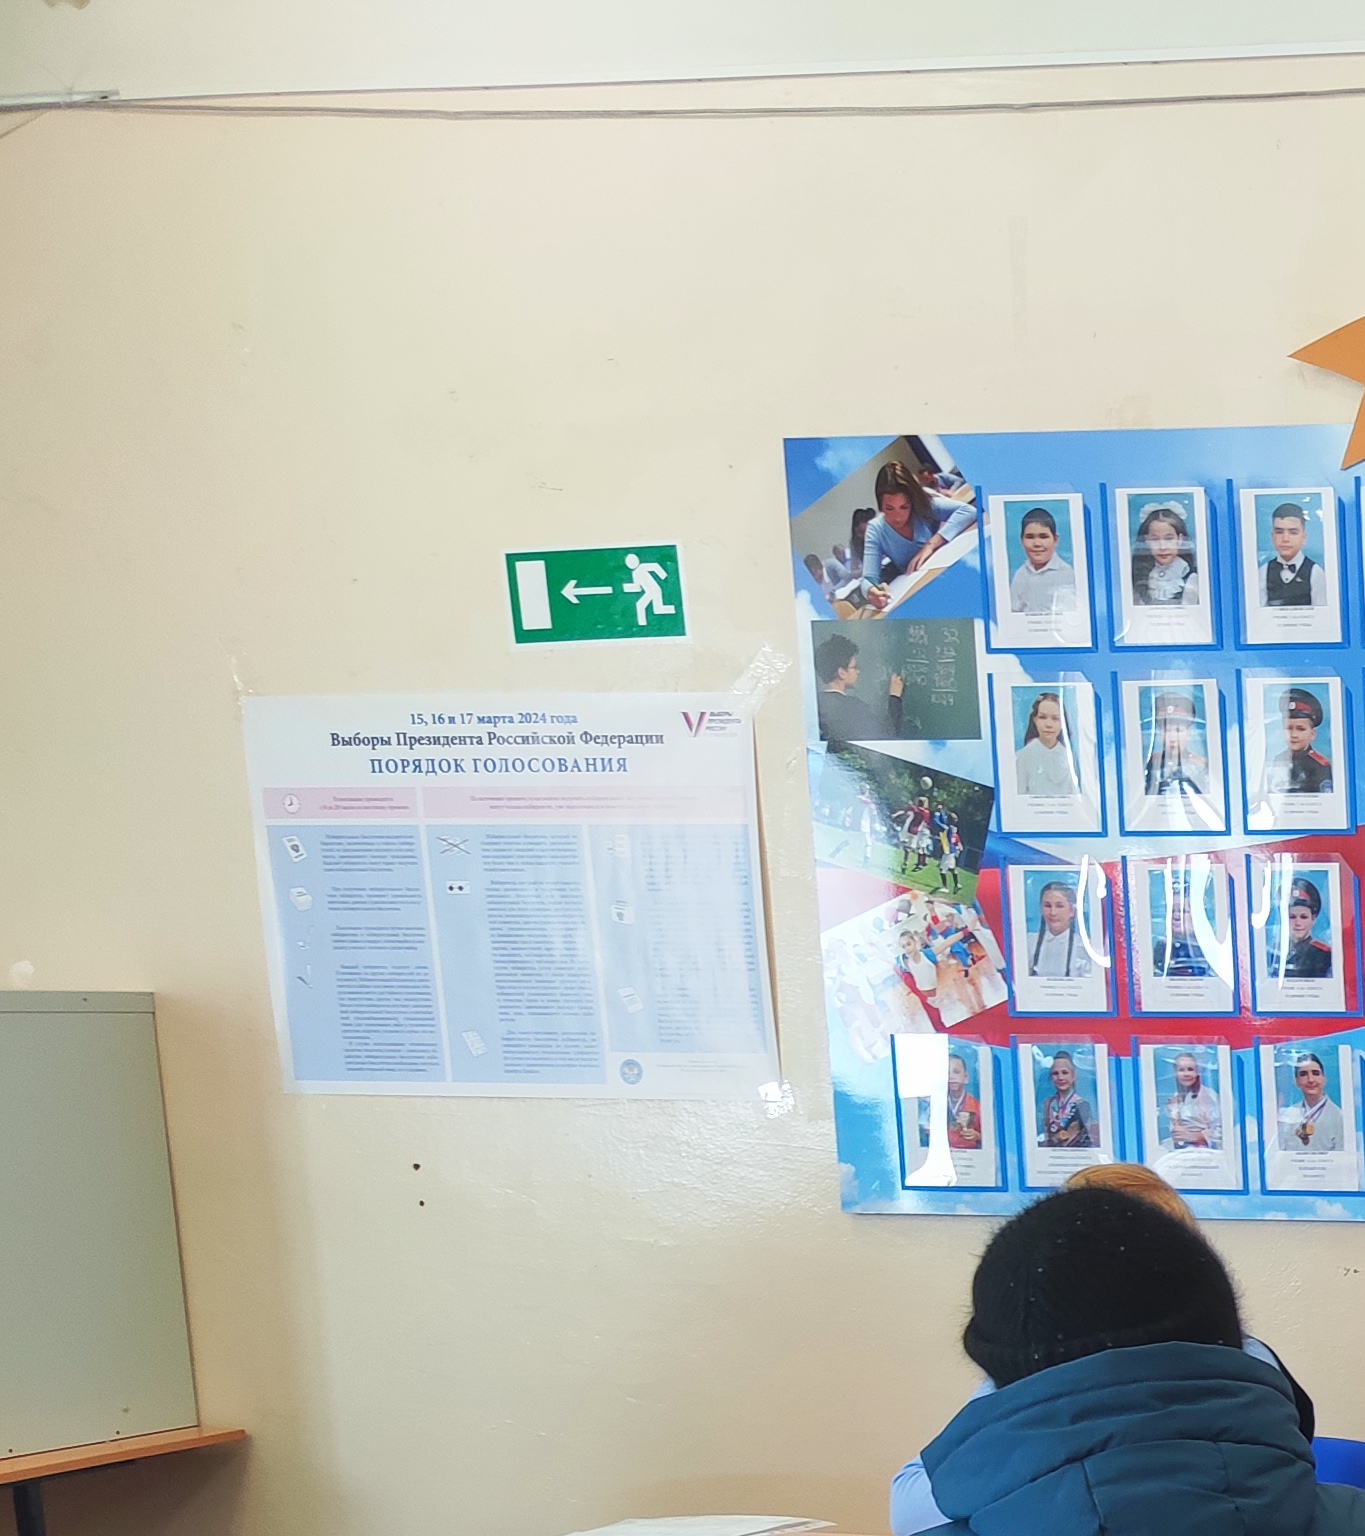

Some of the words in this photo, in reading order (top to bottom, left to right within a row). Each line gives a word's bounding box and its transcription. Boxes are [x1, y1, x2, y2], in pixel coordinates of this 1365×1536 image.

[411, 713, 428, 726] 15,
[431, 713, 445, 724] 16
[448, 716, 456, 725] и
[460, 713, 474, 724] 17
[477, 715, 514, 727] марта
[518, 712, 547, 724] 2024
[550, 715, 578, 725] года
[330, 732, 392, 750] Выборы
[395, 732, 484, 750] Президента
[487, 731, 576, 745] Российской
[579, 731, 665, 749] Федерации
[369, 758, 466, 776] ПОРЯДОК
[472, 757, 628, 773] ГОЛОСОВАНИЯ
